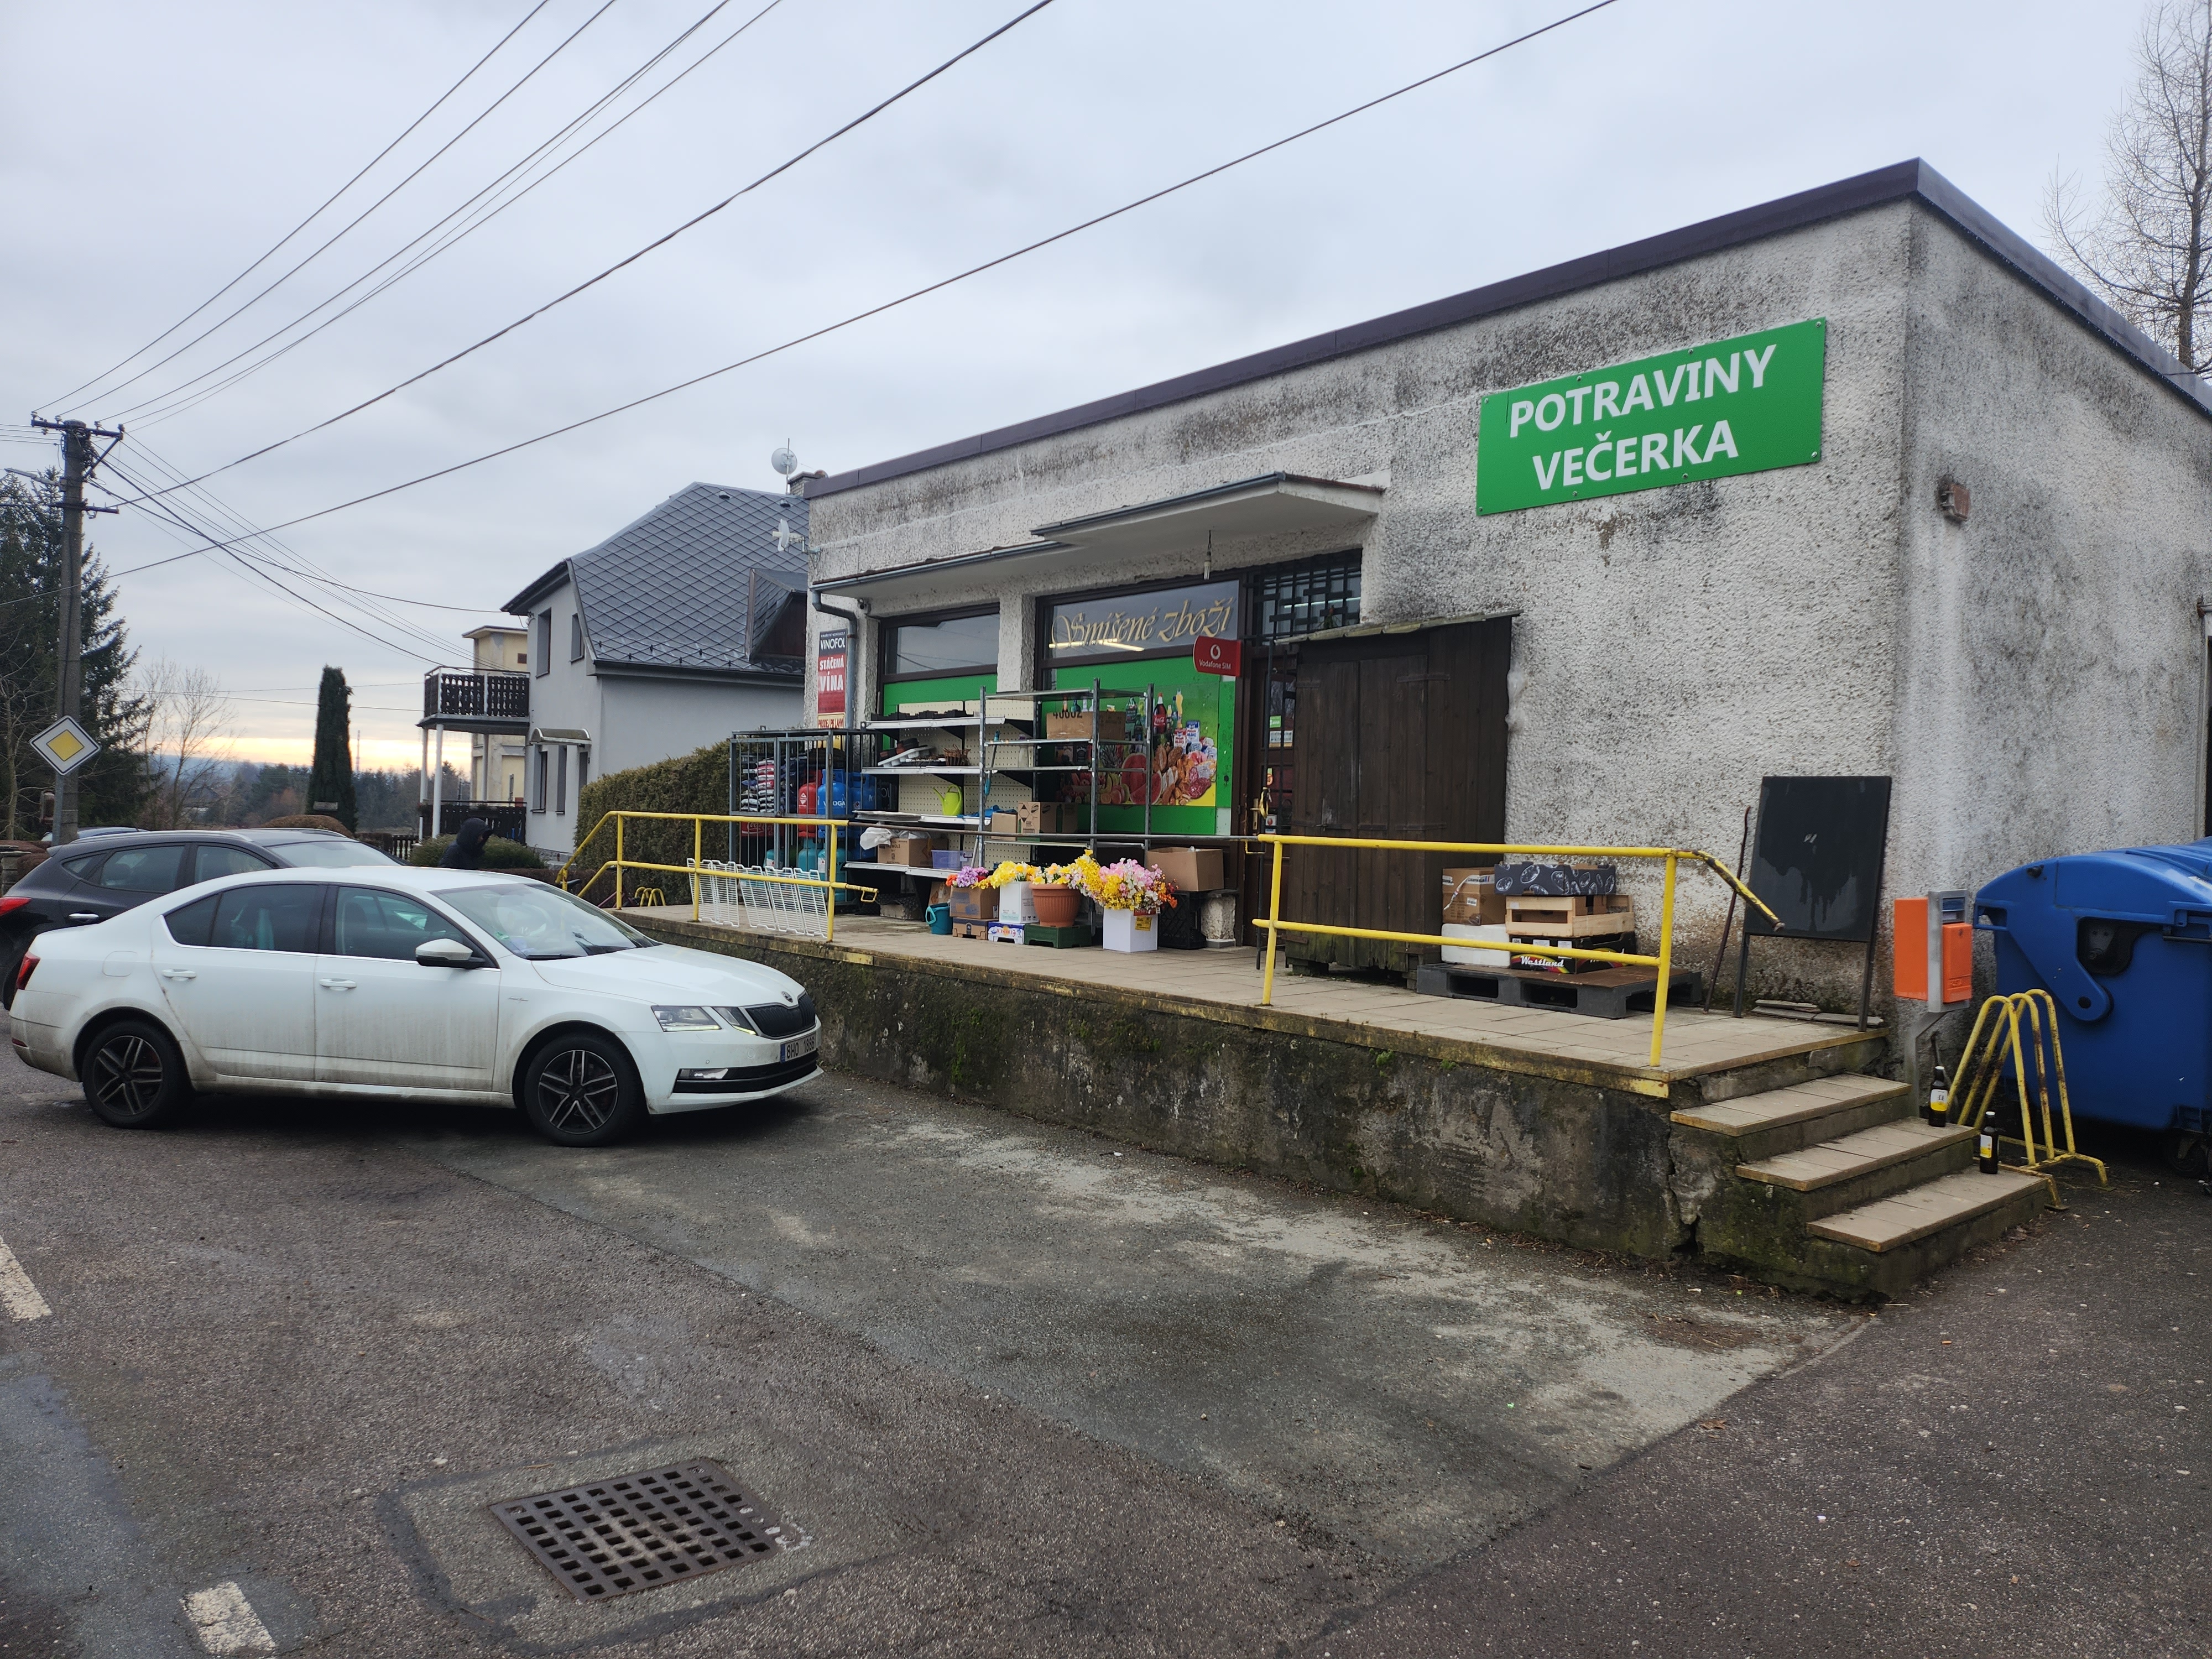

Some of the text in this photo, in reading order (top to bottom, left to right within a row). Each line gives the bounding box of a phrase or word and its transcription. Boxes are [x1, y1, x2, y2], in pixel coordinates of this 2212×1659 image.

[1509, 344, 1777, 438] POTRAVINY
[1532, 419, 1739, 490] VEČERKA
[1051, 597, 1234, 648] Smíšené zboží
[820, 638, 845, 650] VINOFOL
[820, 655, 844, 670] STÁČENÁ
[1199, 659, 1221, 669] Vodafone
[819, 671, 844, 692] VÍNA
[1520, 956, 1564, 967] Westland
[786, 1042, 799, 1058] 8H0
